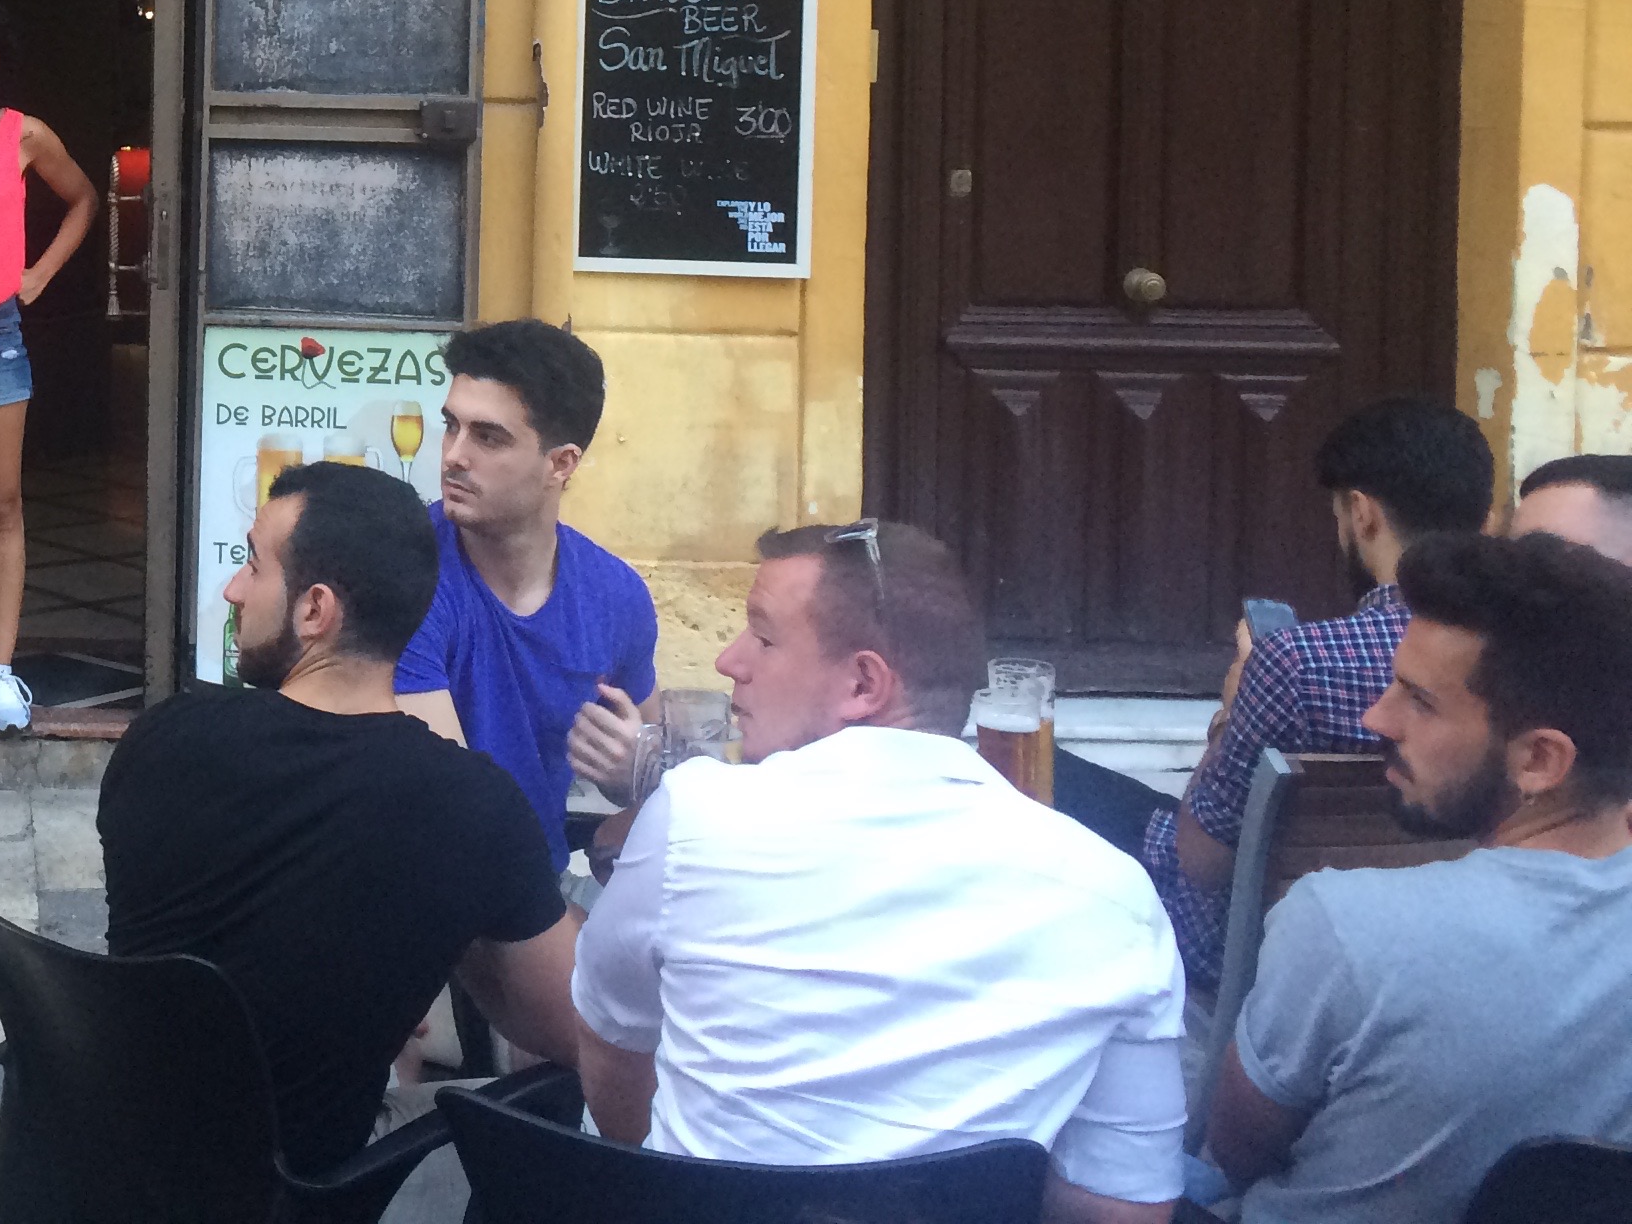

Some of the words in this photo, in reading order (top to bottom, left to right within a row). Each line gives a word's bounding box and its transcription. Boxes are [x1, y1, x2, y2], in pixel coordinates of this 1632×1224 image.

[680, 3, 767, 34] BEER
[598, 26, 668, 72] San
[673, 33, 786, 87] Miguel
[592, 91, 638, 119] RED
[646, 96, 713, 120] WINE
[588, 150, 663, 180] WHITE
[748, 212, 785, 223] MEJOR
[749, 201, 757, 212] Y
[757, 201, 771, 212] LO
[748, 232, 769, 242] POR
[748, 242, 786, 253] LLEGAR
[218, 342, 446, 387] CERVEZAS
[216, 403, 250, 426] DE
[262, 404, 347, 429] BARRIL
